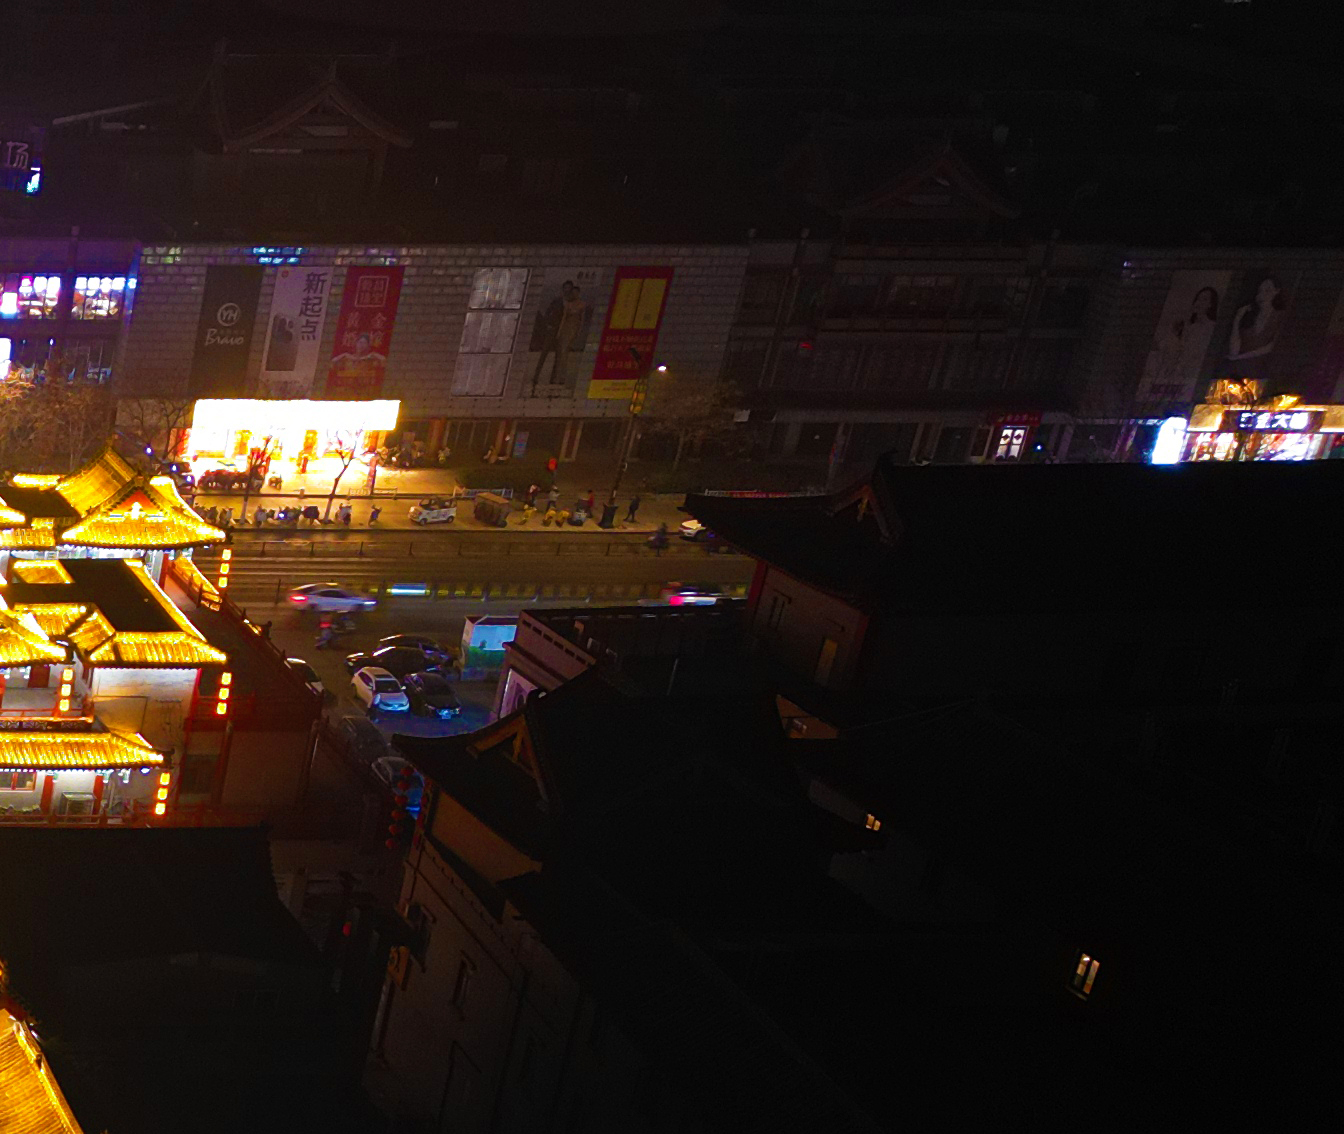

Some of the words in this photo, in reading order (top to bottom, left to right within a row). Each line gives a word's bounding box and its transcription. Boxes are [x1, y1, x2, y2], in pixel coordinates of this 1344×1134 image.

[298, 271, 328, 341] 新起点
[204, 328, 244, 347] Bravo
